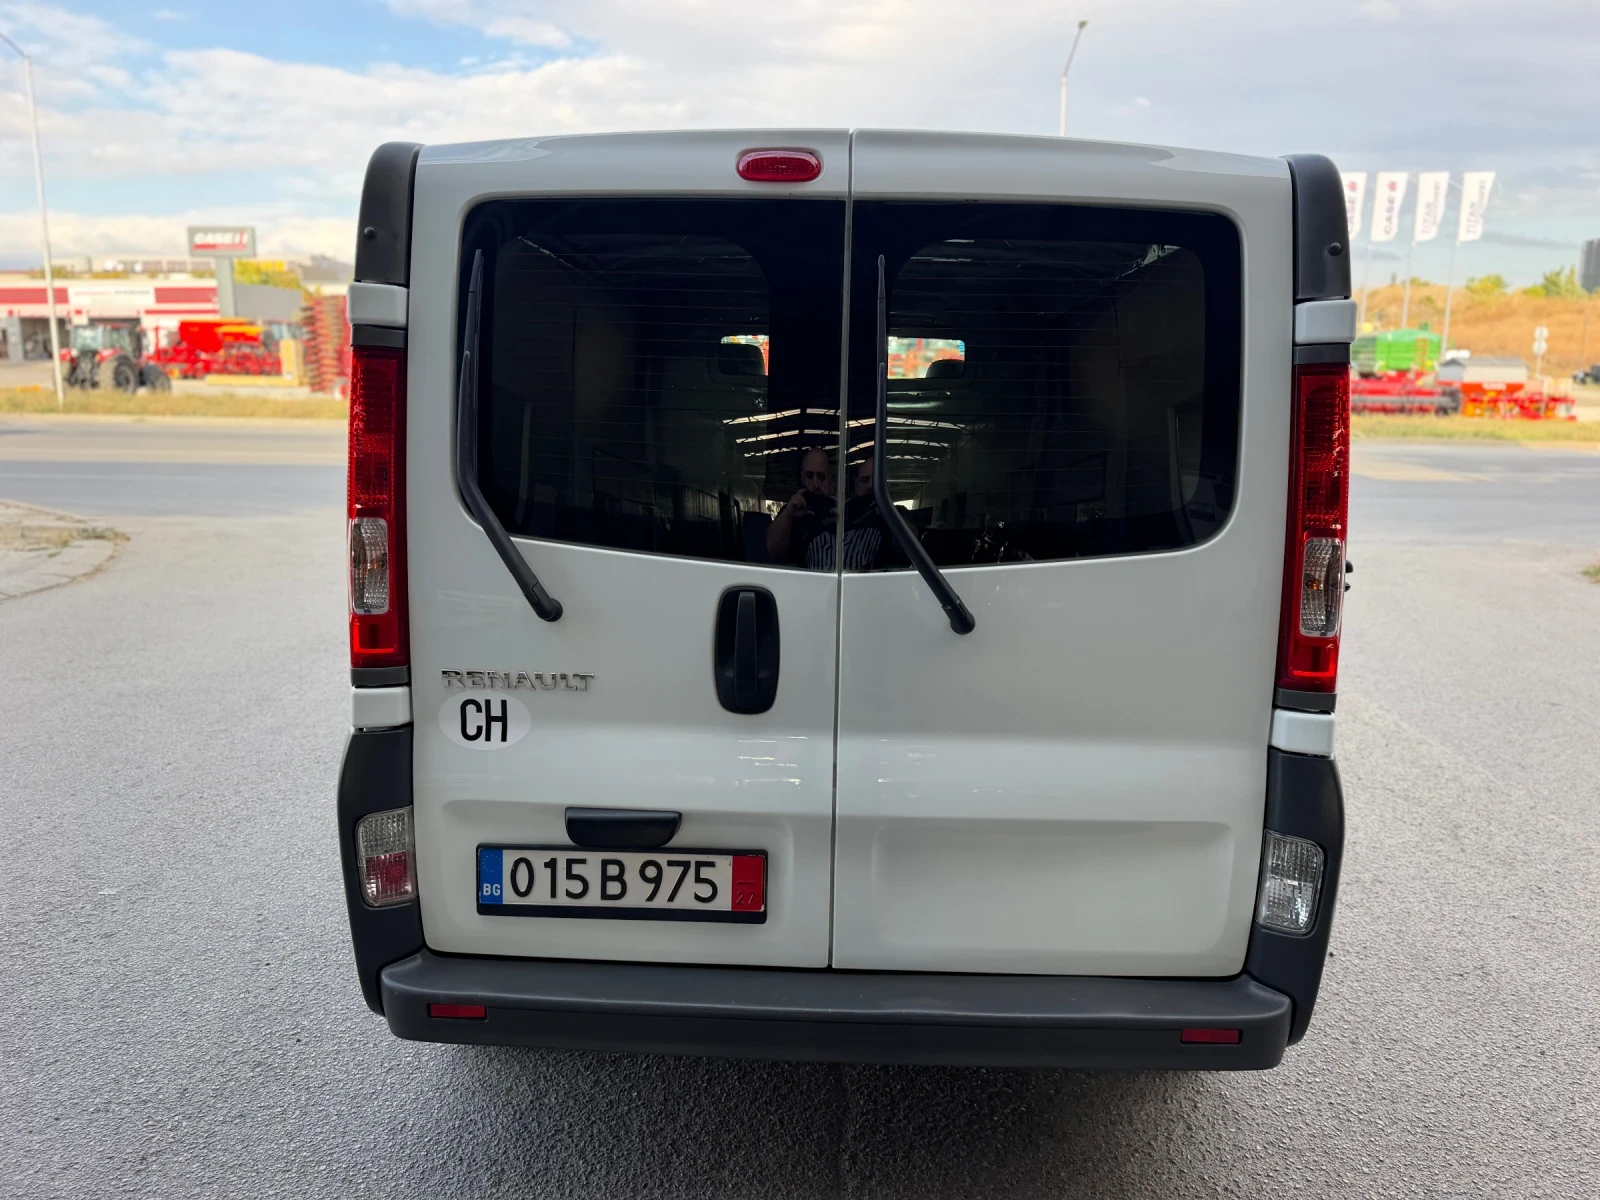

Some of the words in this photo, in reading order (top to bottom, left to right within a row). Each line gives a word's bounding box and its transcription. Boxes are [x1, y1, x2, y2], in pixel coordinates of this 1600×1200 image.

[441, 668, 595, 691] RENAULT
[460, 698, 508, 742] CH
[483, 883, 501, 896] BG
